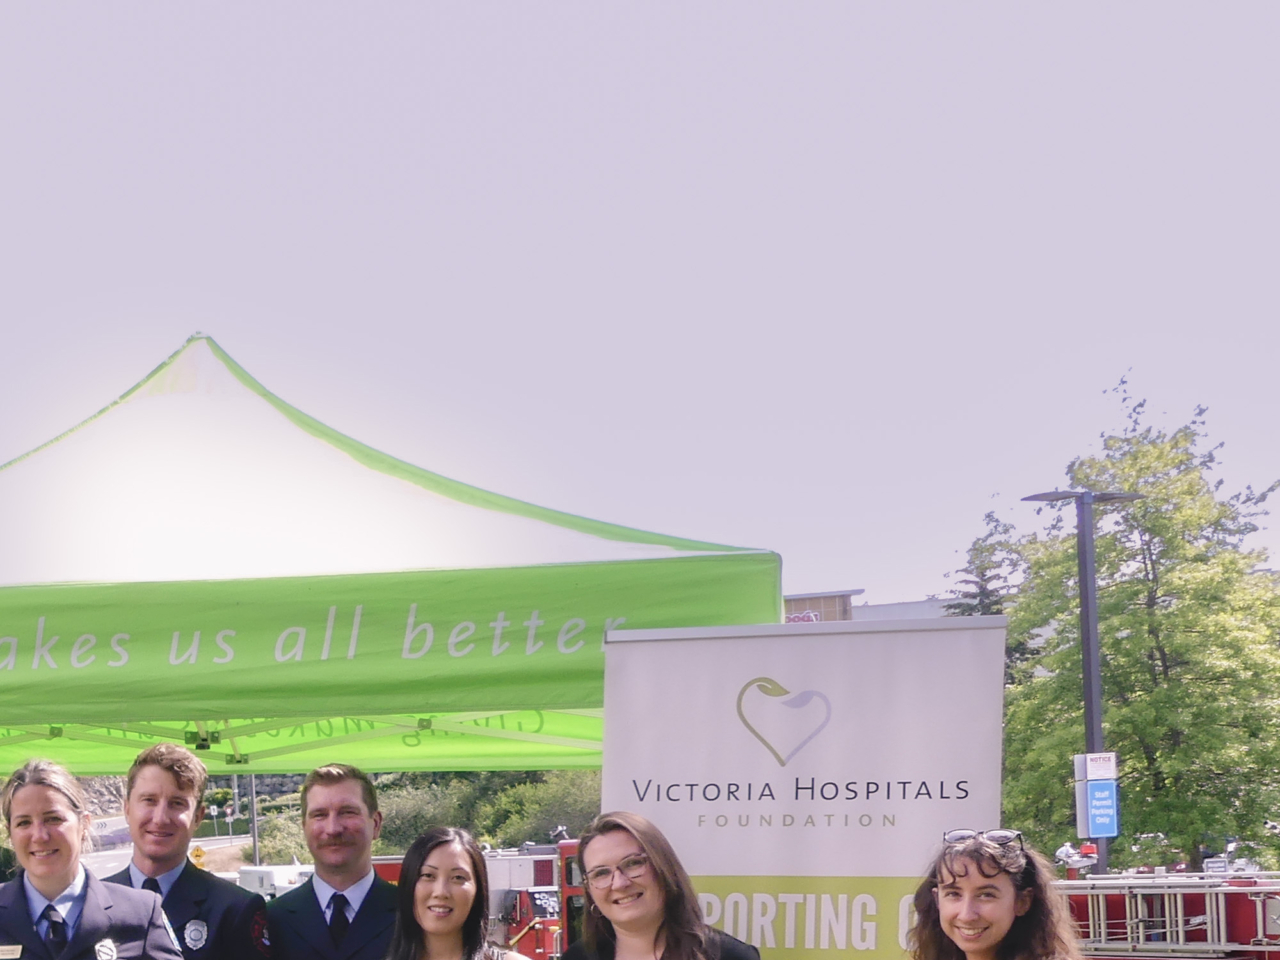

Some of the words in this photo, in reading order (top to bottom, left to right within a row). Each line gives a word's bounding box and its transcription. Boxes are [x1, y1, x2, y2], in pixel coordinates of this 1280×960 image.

[168, 628, 236, 666] us
[274, 603, 363, 663] all
[697, 814, 896, 827] FOUNDATION
[1095, 816, 1110, 824] Only
